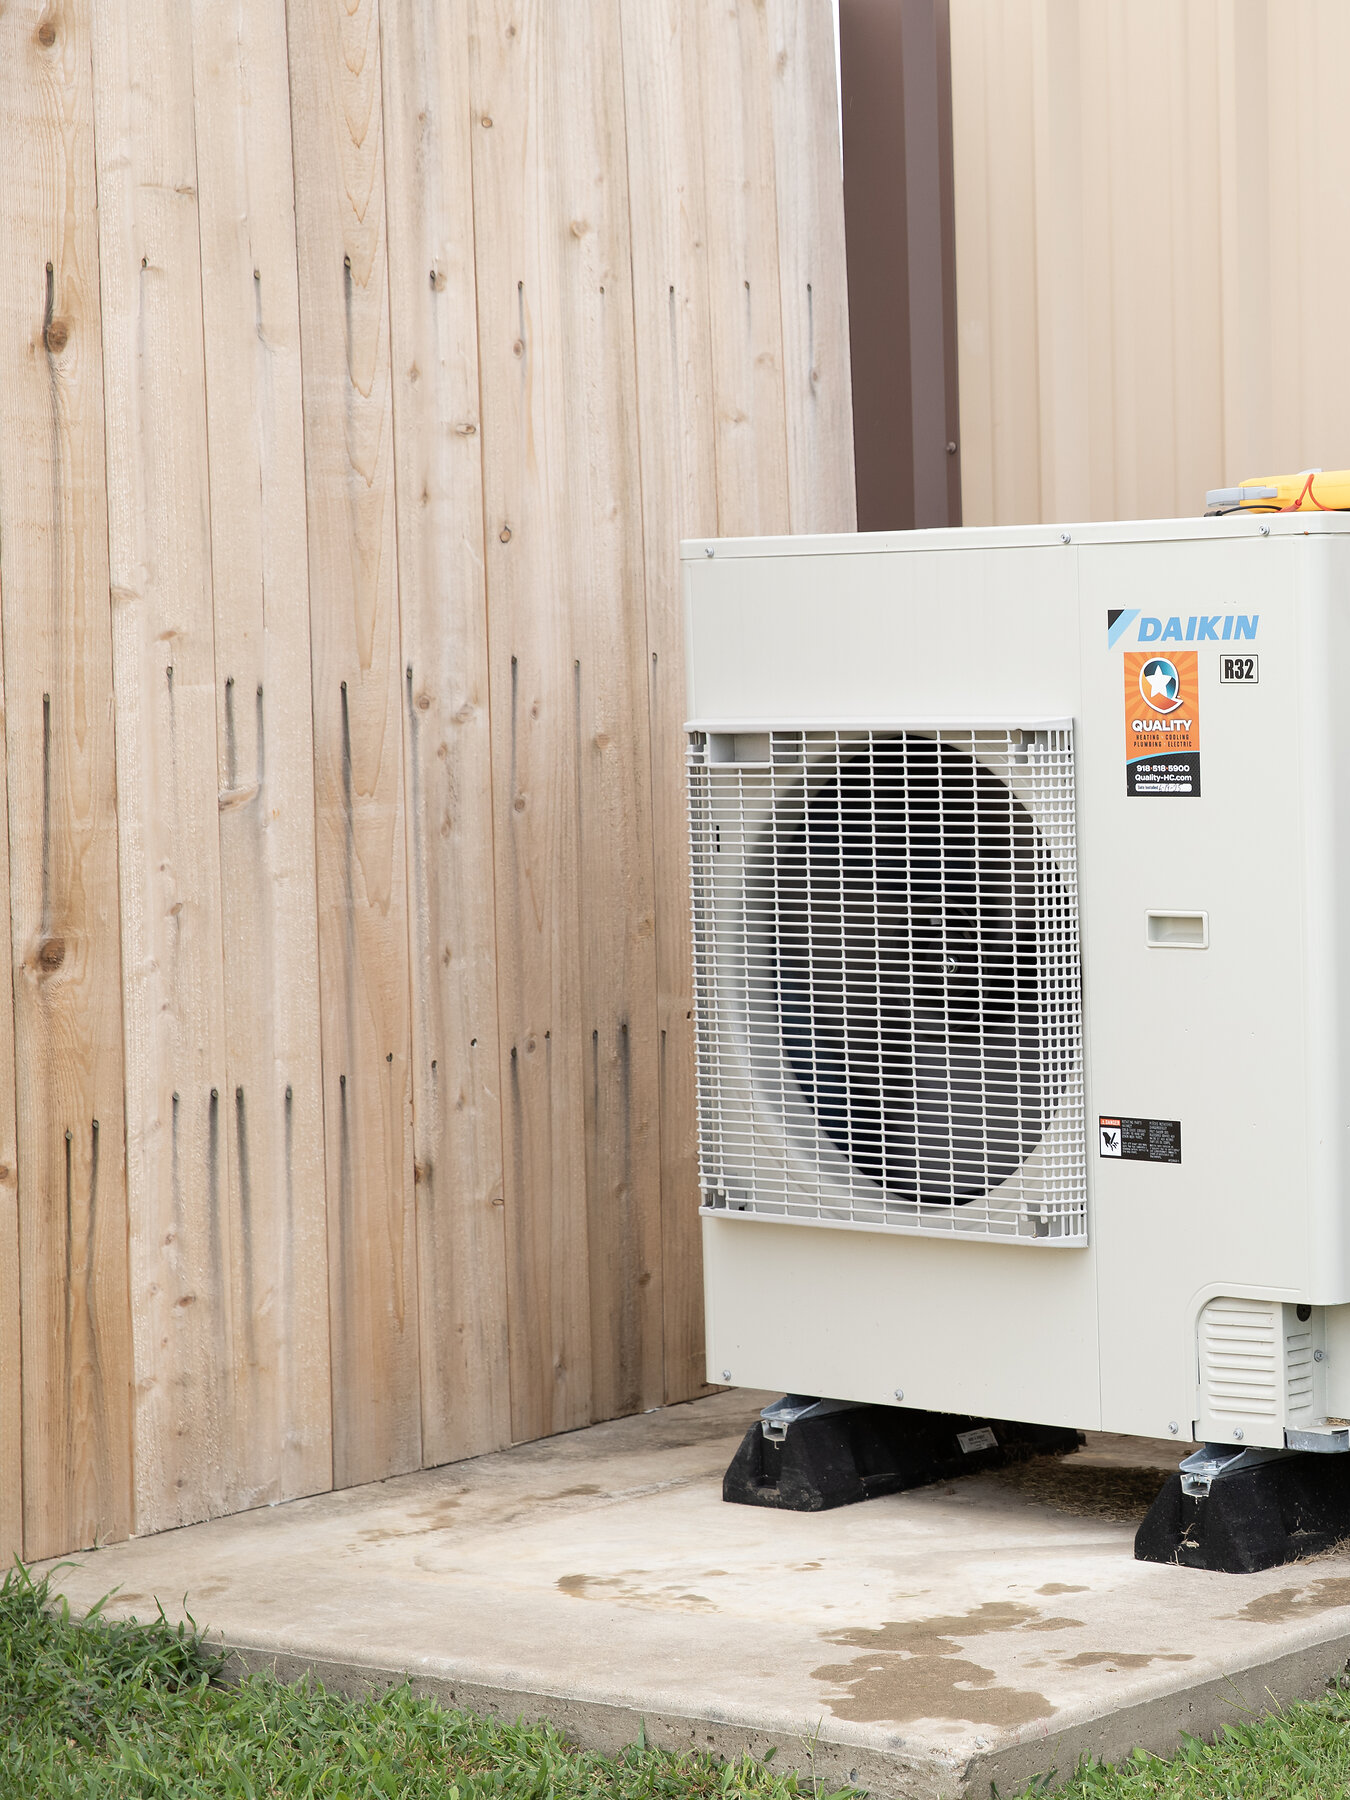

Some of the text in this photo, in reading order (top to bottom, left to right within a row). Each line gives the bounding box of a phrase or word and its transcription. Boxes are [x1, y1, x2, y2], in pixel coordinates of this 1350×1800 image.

[1137, 615, 1260, 642] DAIKIN
[1224, 658, 1254, 679] R32
[1131, 719, 1192, 732] QUALITY
[1134, 774, 1192, 782] Quality-HC.com
